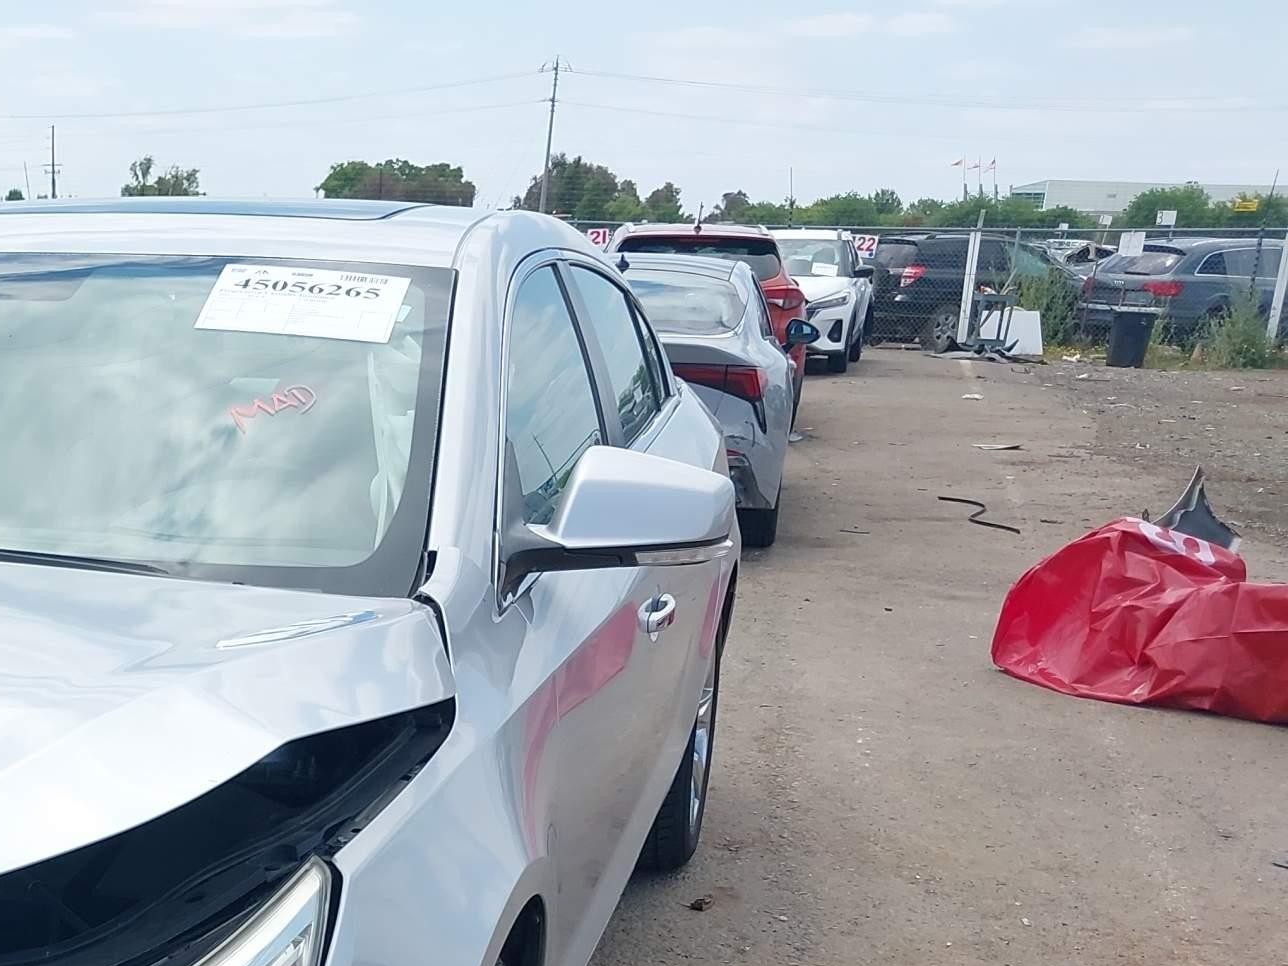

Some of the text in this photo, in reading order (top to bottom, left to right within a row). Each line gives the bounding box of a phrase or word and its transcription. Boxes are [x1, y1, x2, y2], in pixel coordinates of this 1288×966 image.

[590, 230, 607, 245] 21
[856, 236, 876, 251] 22
[233, 277, 382, 301] 45056265
